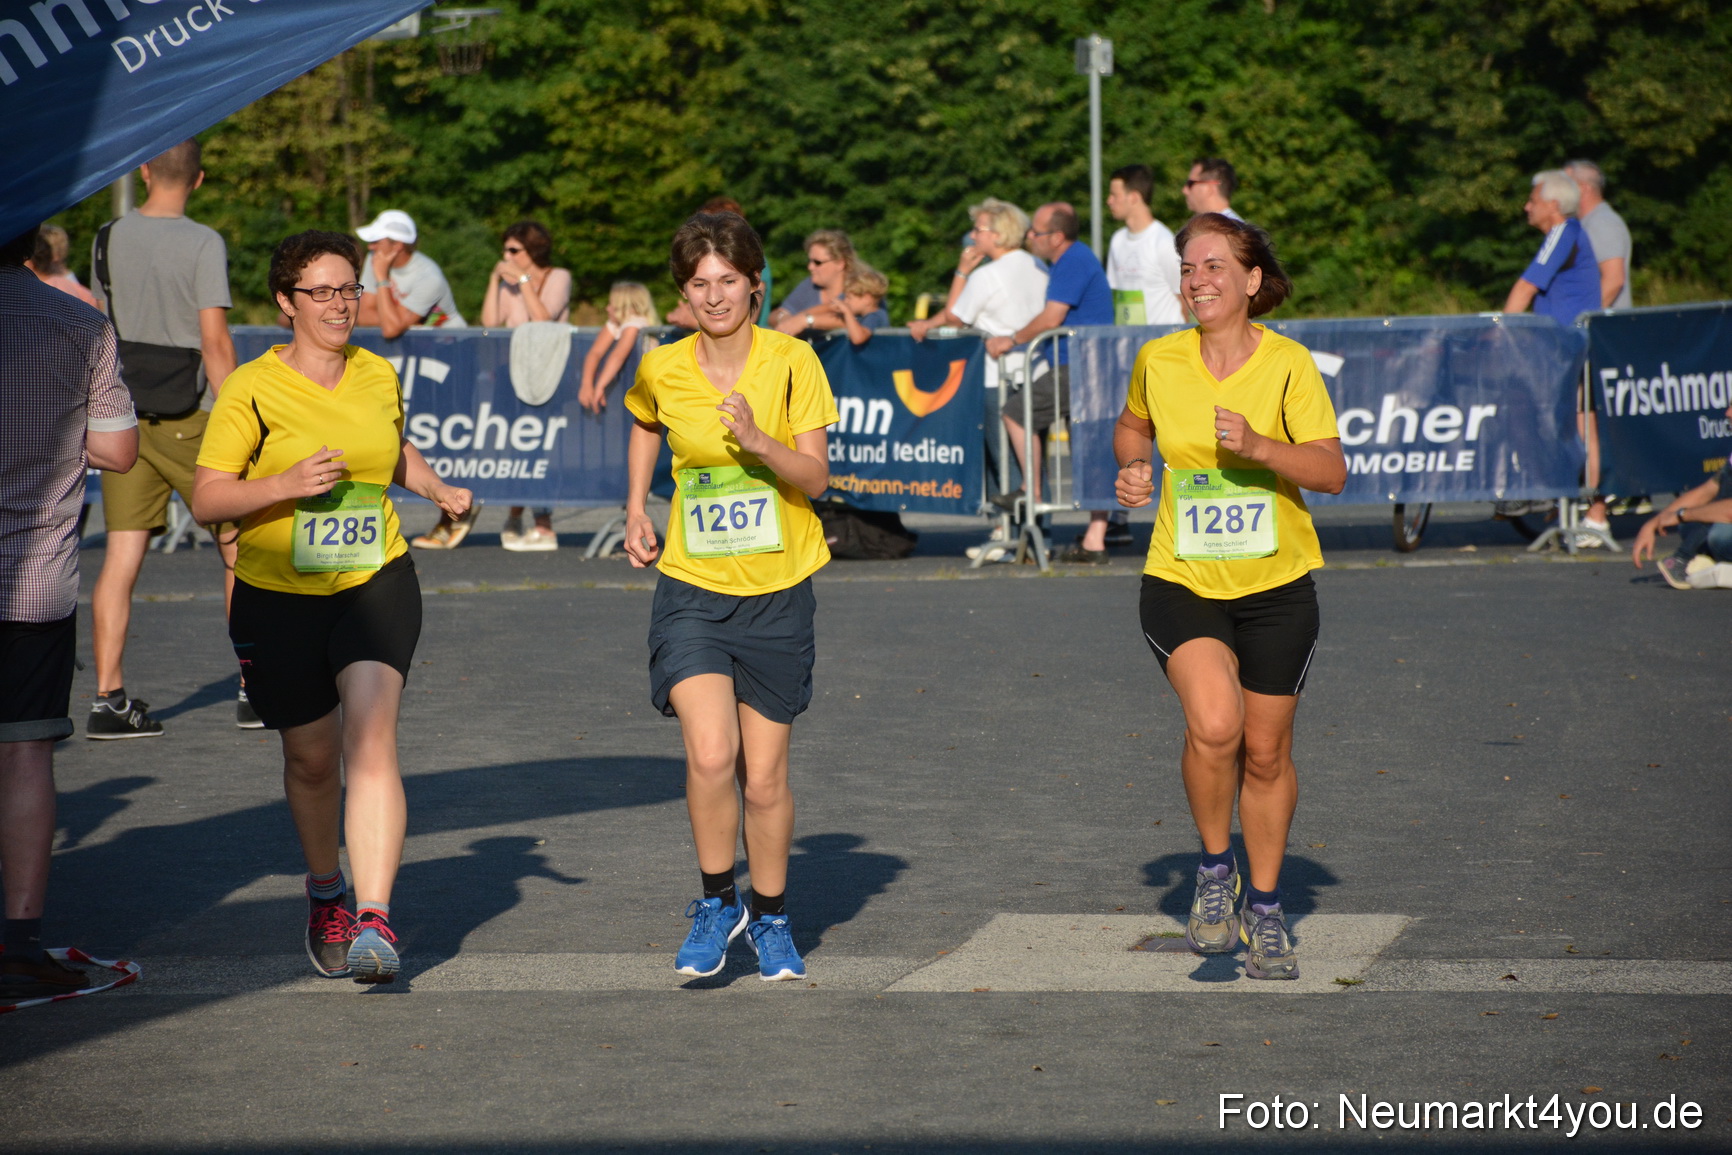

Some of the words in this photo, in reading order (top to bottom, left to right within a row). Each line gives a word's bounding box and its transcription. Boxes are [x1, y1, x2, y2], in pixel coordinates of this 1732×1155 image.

[110, 0, 235, 74] Druck
[403, 402, 567, 451] scher
[826, 396, 895, 435] nn
[1336, 393, 1498, 446] cher
[1698, 414, 1732, 440] Druc
[828, 437, 846, 462] ck
[849, 440, 887, 464] und
[1346, 450, 1477, 475] MOBILE
[425, 456, 549, 479] OMOBILE
[690, 498, 768, 532] 1267
[1185, 503, 1266, 534] 1287
[303, 516, 377, 546] 1285
